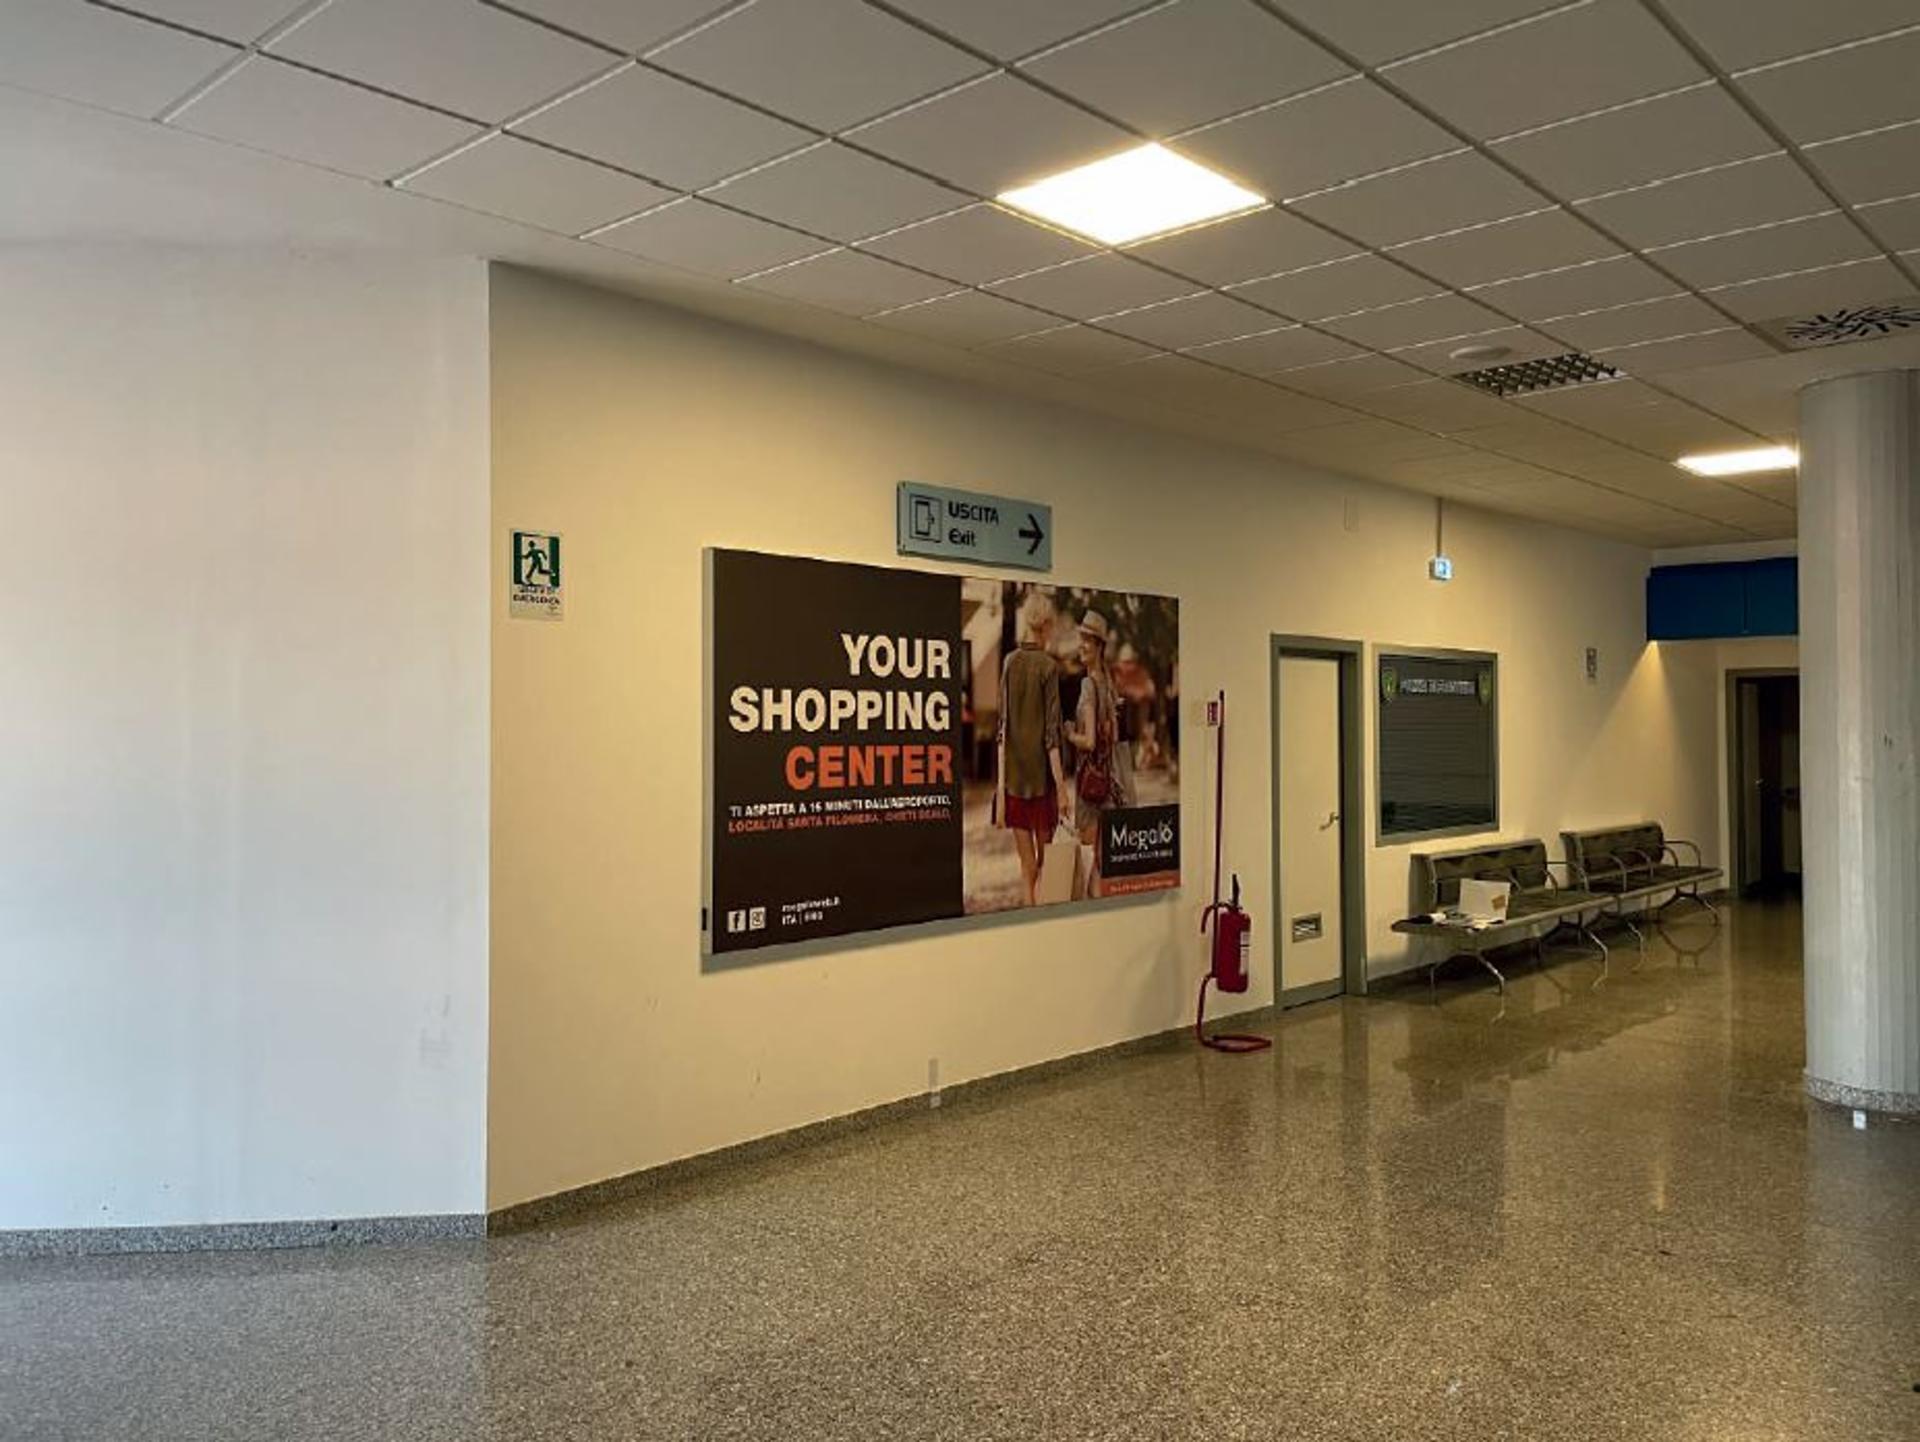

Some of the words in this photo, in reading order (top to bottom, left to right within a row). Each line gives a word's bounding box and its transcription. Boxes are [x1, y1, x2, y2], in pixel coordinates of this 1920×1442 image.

[948, 502, 999, 525] USCITA
[948, 528, 977, 547] Exit
[841, 633, 951, 679] YOUR
[728, 686, 950, 732] SHOPPING
[785, 745, 953, 790] CENTER
[729, 805, 743, 817] TI
[745, 802, 796, 817] ASPETTA
[799, 802, 807, 813] A
[825, 800, 863, 812] MINUTI
